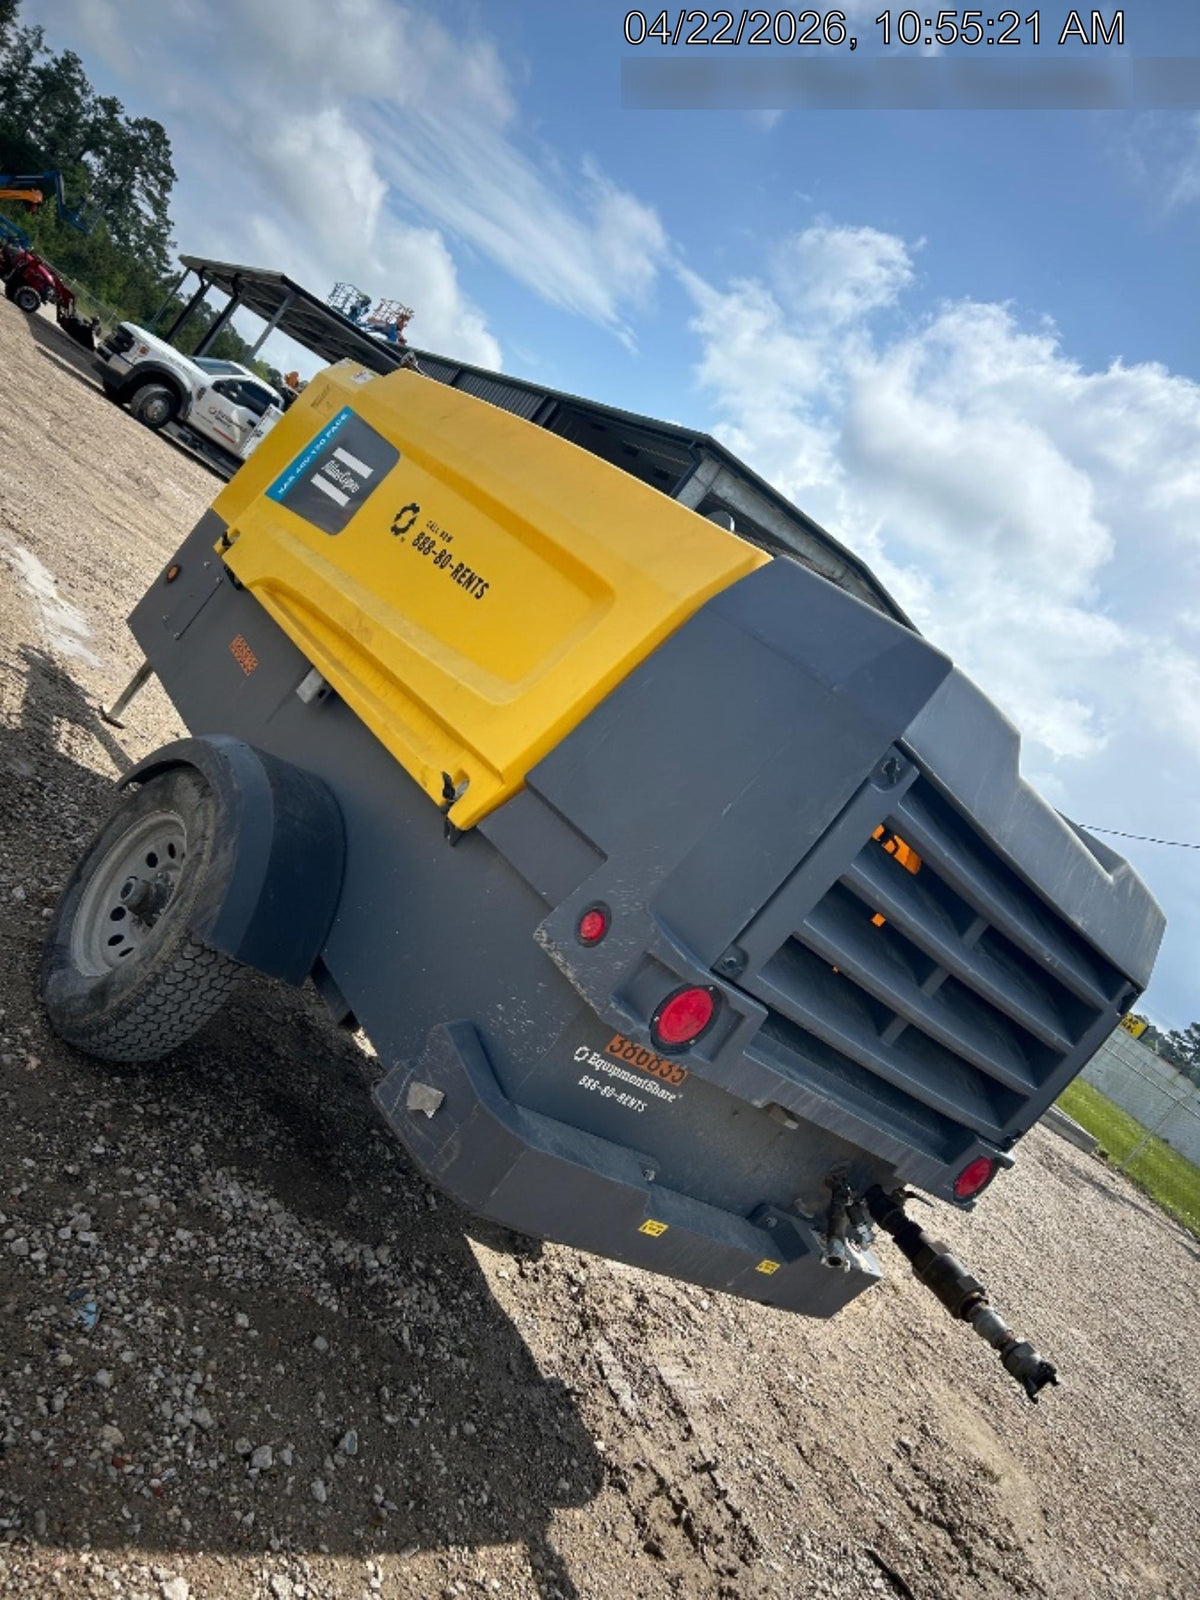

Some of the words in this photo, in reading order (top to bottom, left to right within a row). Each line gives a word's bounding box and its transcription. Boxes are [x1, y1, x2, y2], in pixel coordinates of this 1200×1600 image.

[412, 531, 490, 600] 888-80-RENTS
[578, 1074, 649, 1113] 888-80-RENTS
[587, 1051, 677, 1103] EquipmentShare
